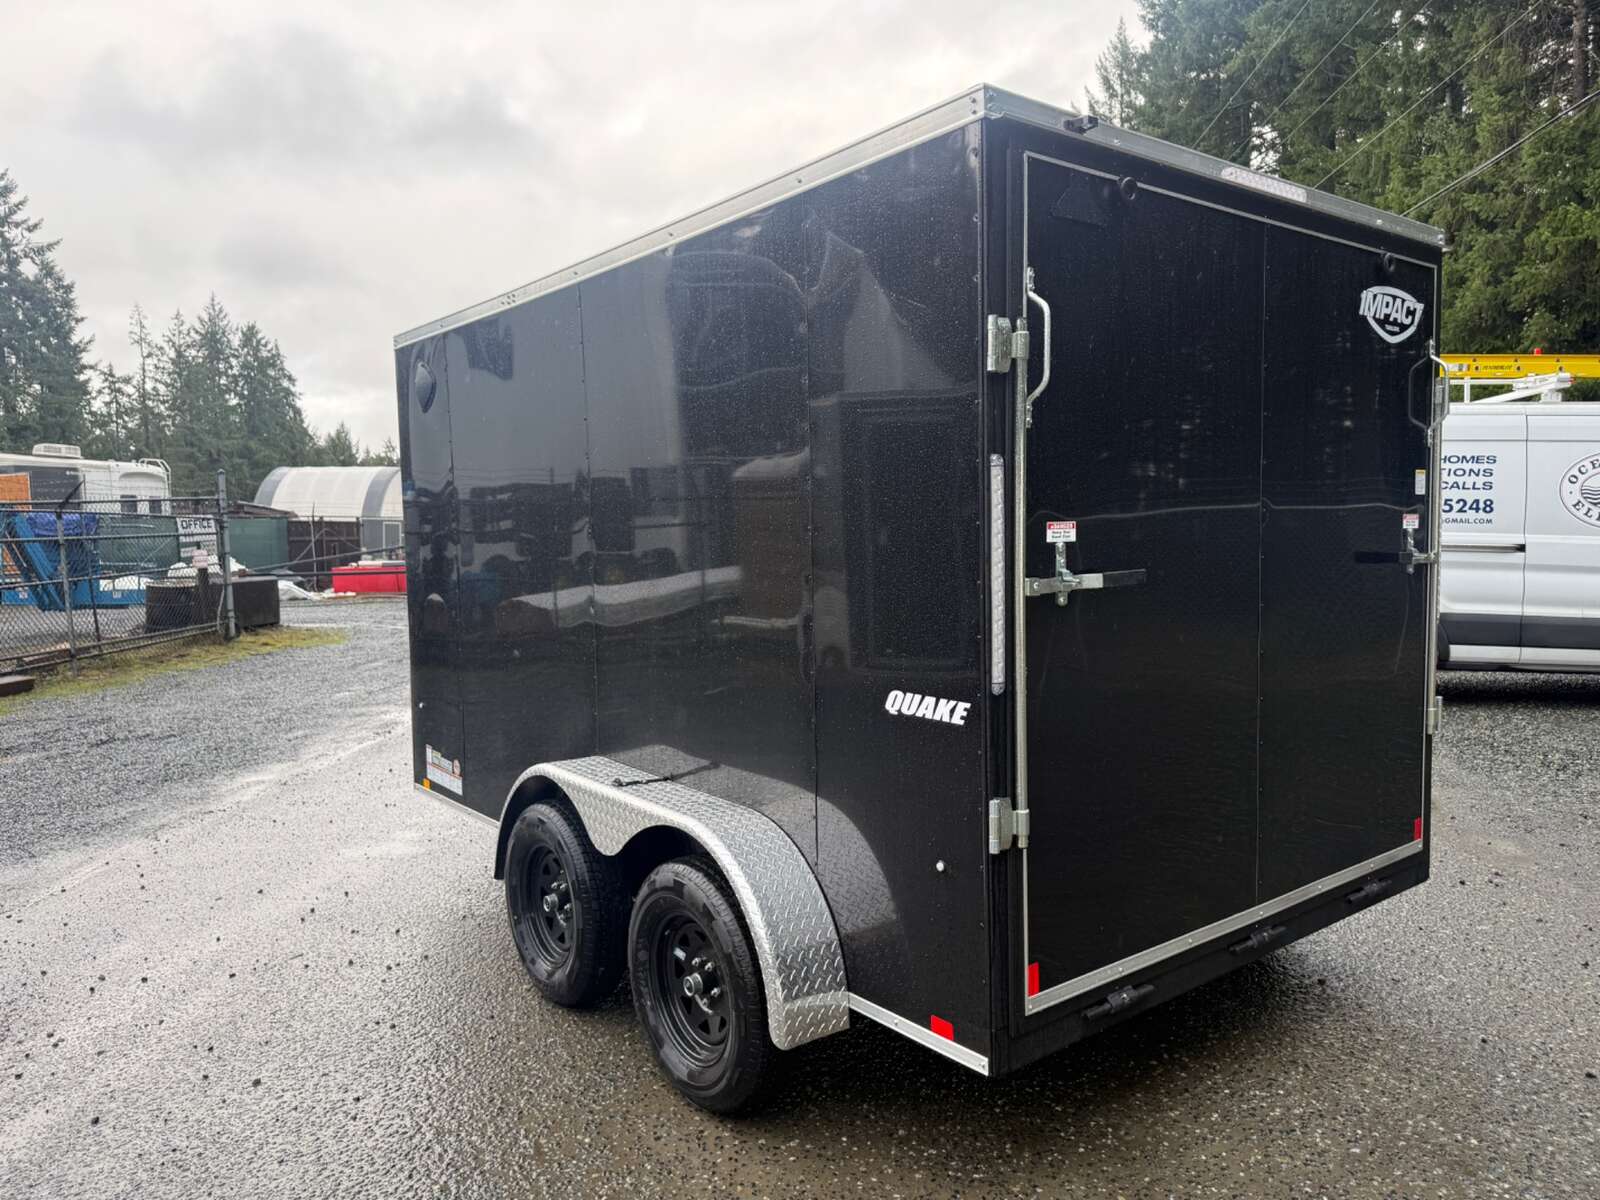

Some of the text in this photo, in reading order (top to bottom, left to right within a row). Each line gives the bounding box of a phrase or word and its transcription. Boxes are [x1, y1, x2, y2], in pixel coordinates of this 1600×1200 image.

[1359, 290, 1424, 326] IMPACT
[1568, 459, 1600, 485] OCE
[1441, 481, 1494, 490] CALLS
[1442, 498, 1494, 514] 5248
[181, 520, 213, 529] OFFICE
[885, 690, 971, 725] QUAKE
